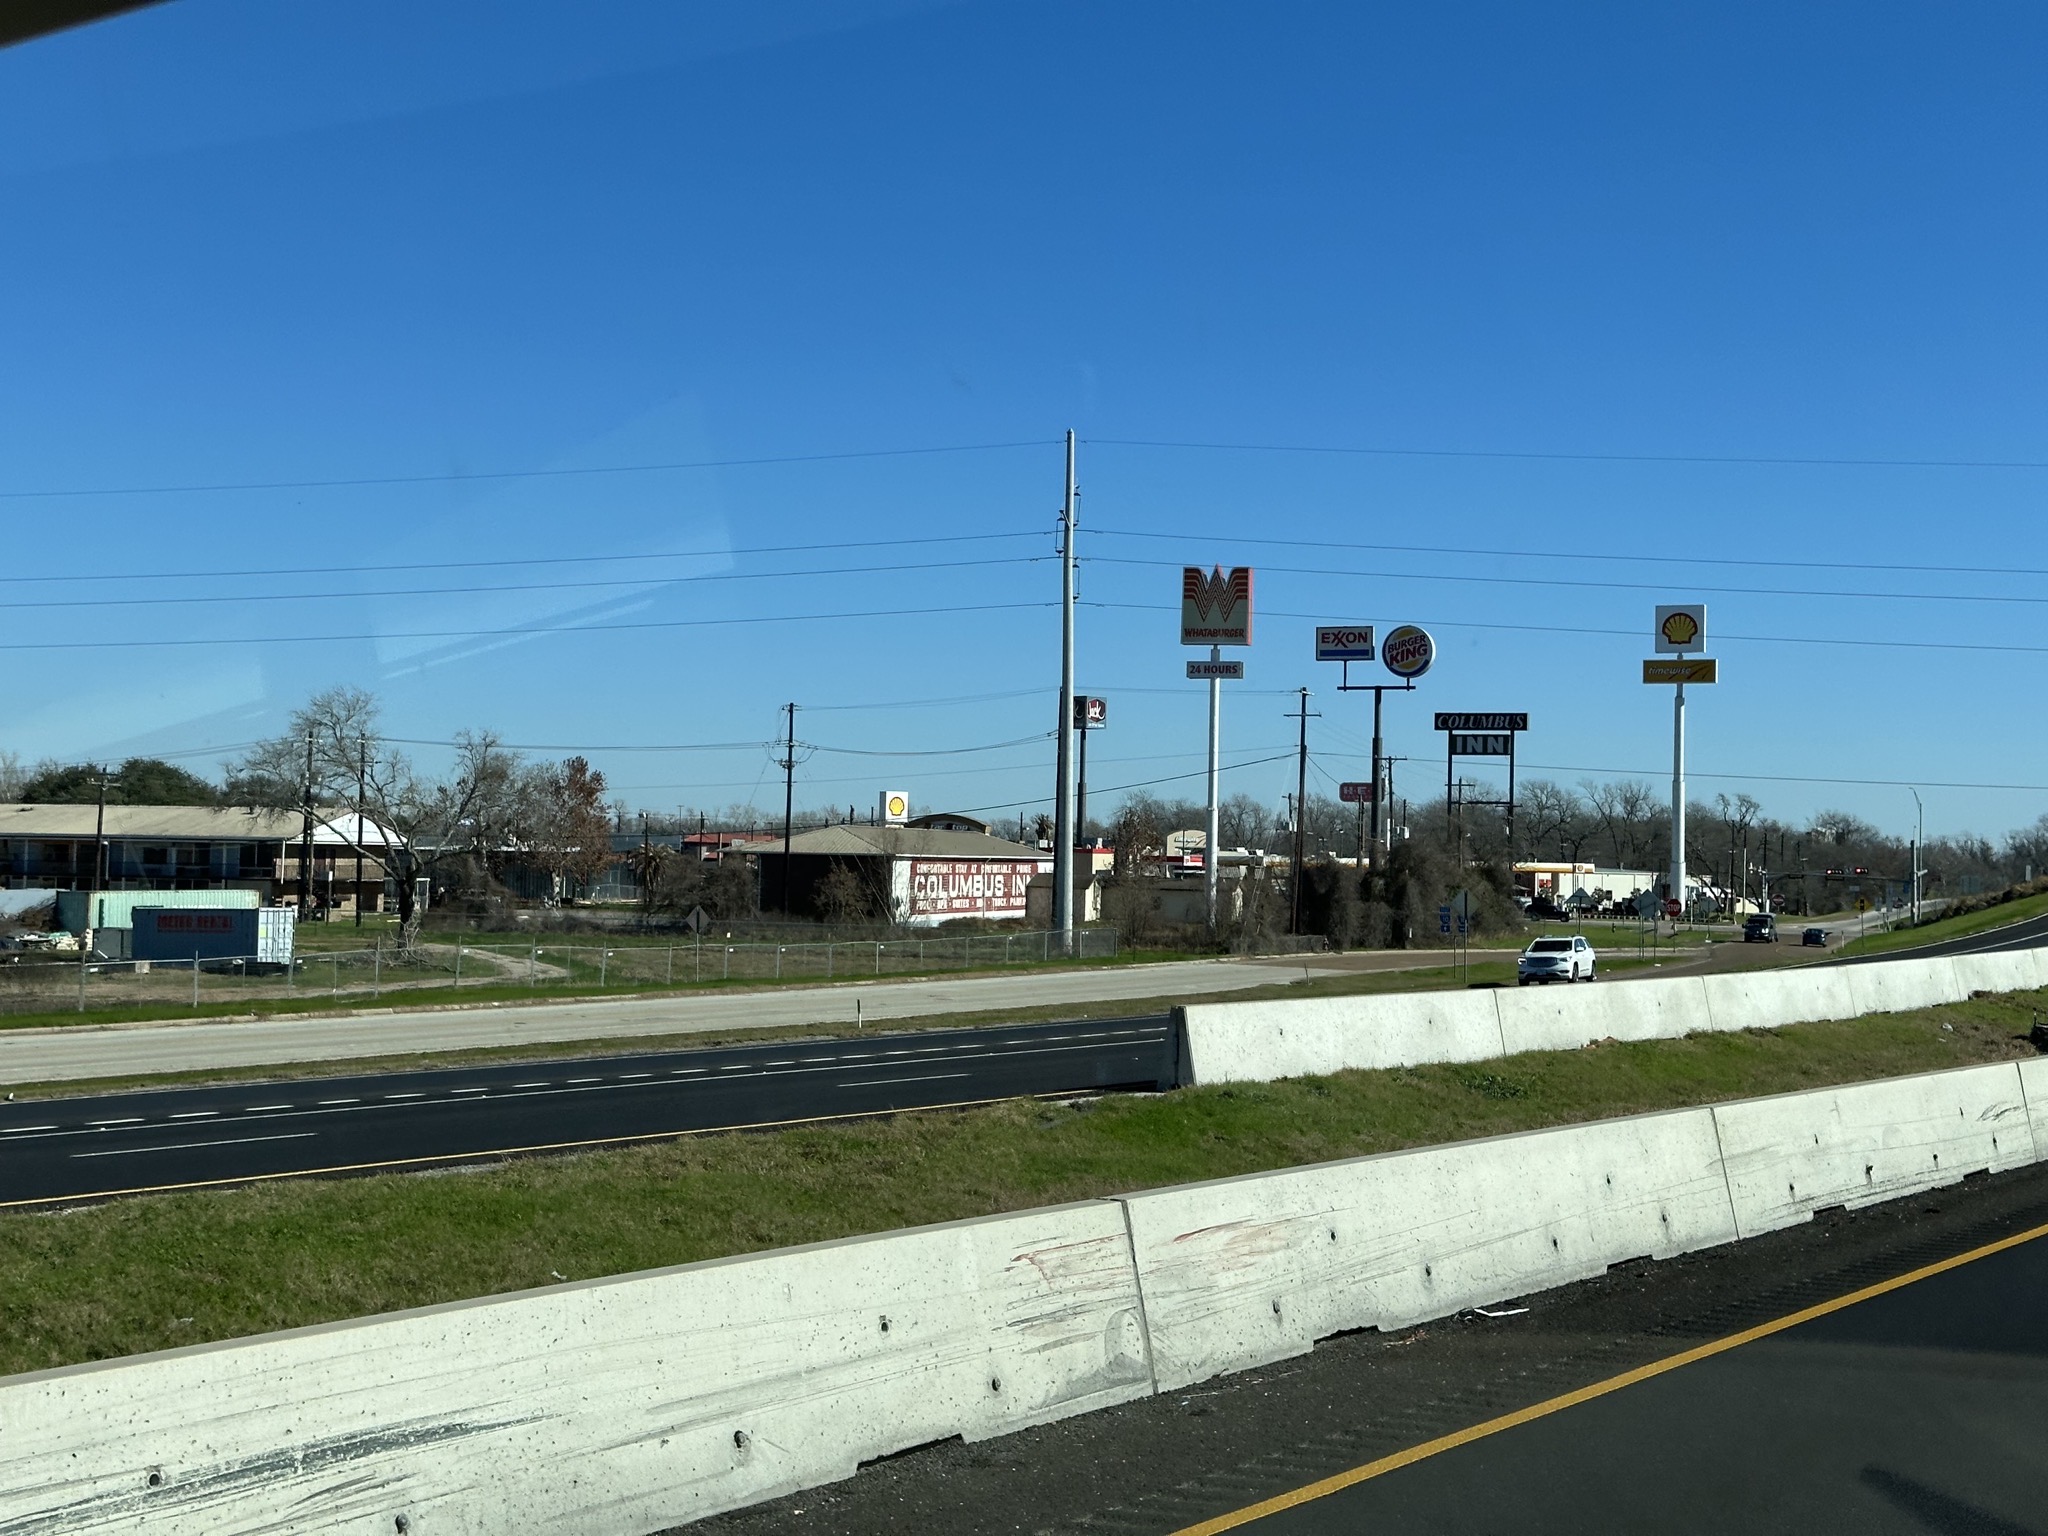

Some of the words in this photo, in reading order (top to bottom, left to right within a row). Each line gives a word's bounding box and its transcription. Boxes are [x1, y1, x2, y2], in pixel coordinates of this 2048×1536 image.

[1184, 629, 1245, 638] WHATABURGER
[1321, 630, 1368, 648] EXXON
[1387, 634, 1427, 655] BURGER
[1389, 643, 1428, 667] KING
[1189, 665, 1202, 674] 24
[1204, 665, 1238, 674] HOURS
[1648, 665, 1692, 675] timewise
[1437, 714, 1525, 729] COLUMBUS
[1456, 736, 1505, 754] INN
[917, 863, 953, 874] COMFORTABLE
[955, 864, 968, 874] STAY
[970, 864, 978, 874] AT
[981, 864, 1012, 874] CMFORTABLE
[914, 874, 1005, 899] COLUMBUS
[952, 898, 970, 909] SUITES
[1666, 903, 1681, 912] STOP
